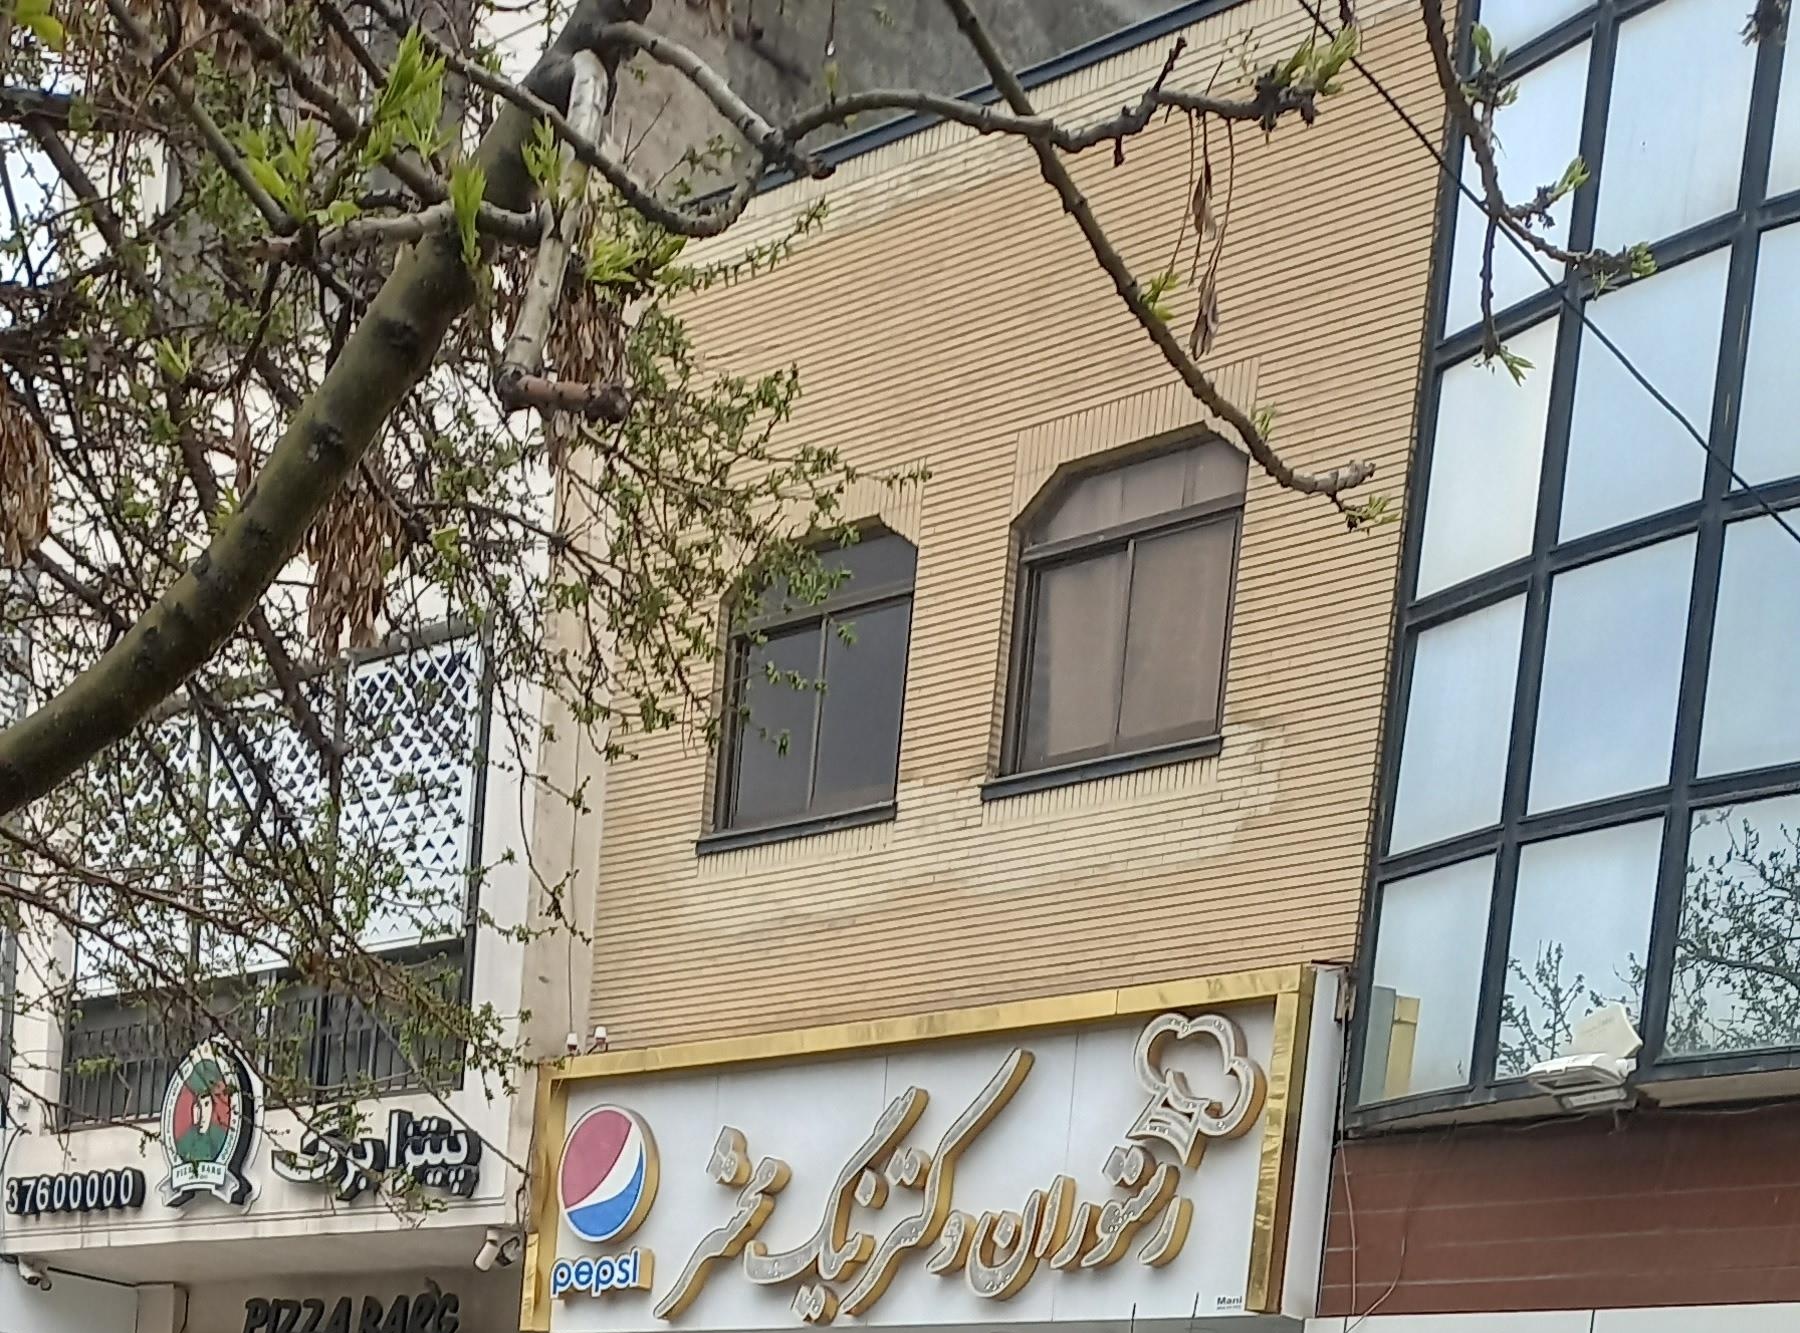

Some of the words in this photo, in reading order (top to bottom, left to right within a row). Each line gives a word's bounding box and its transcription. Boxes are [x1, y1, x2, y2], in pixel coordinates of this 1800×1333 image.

[6, 1168, 140, 1215] 37600000
[653, 1124, 790, 1318] محشر
[965, 1144, 1190, 1298] رستوران
[551, 1248, 641, 1297] pepsi
